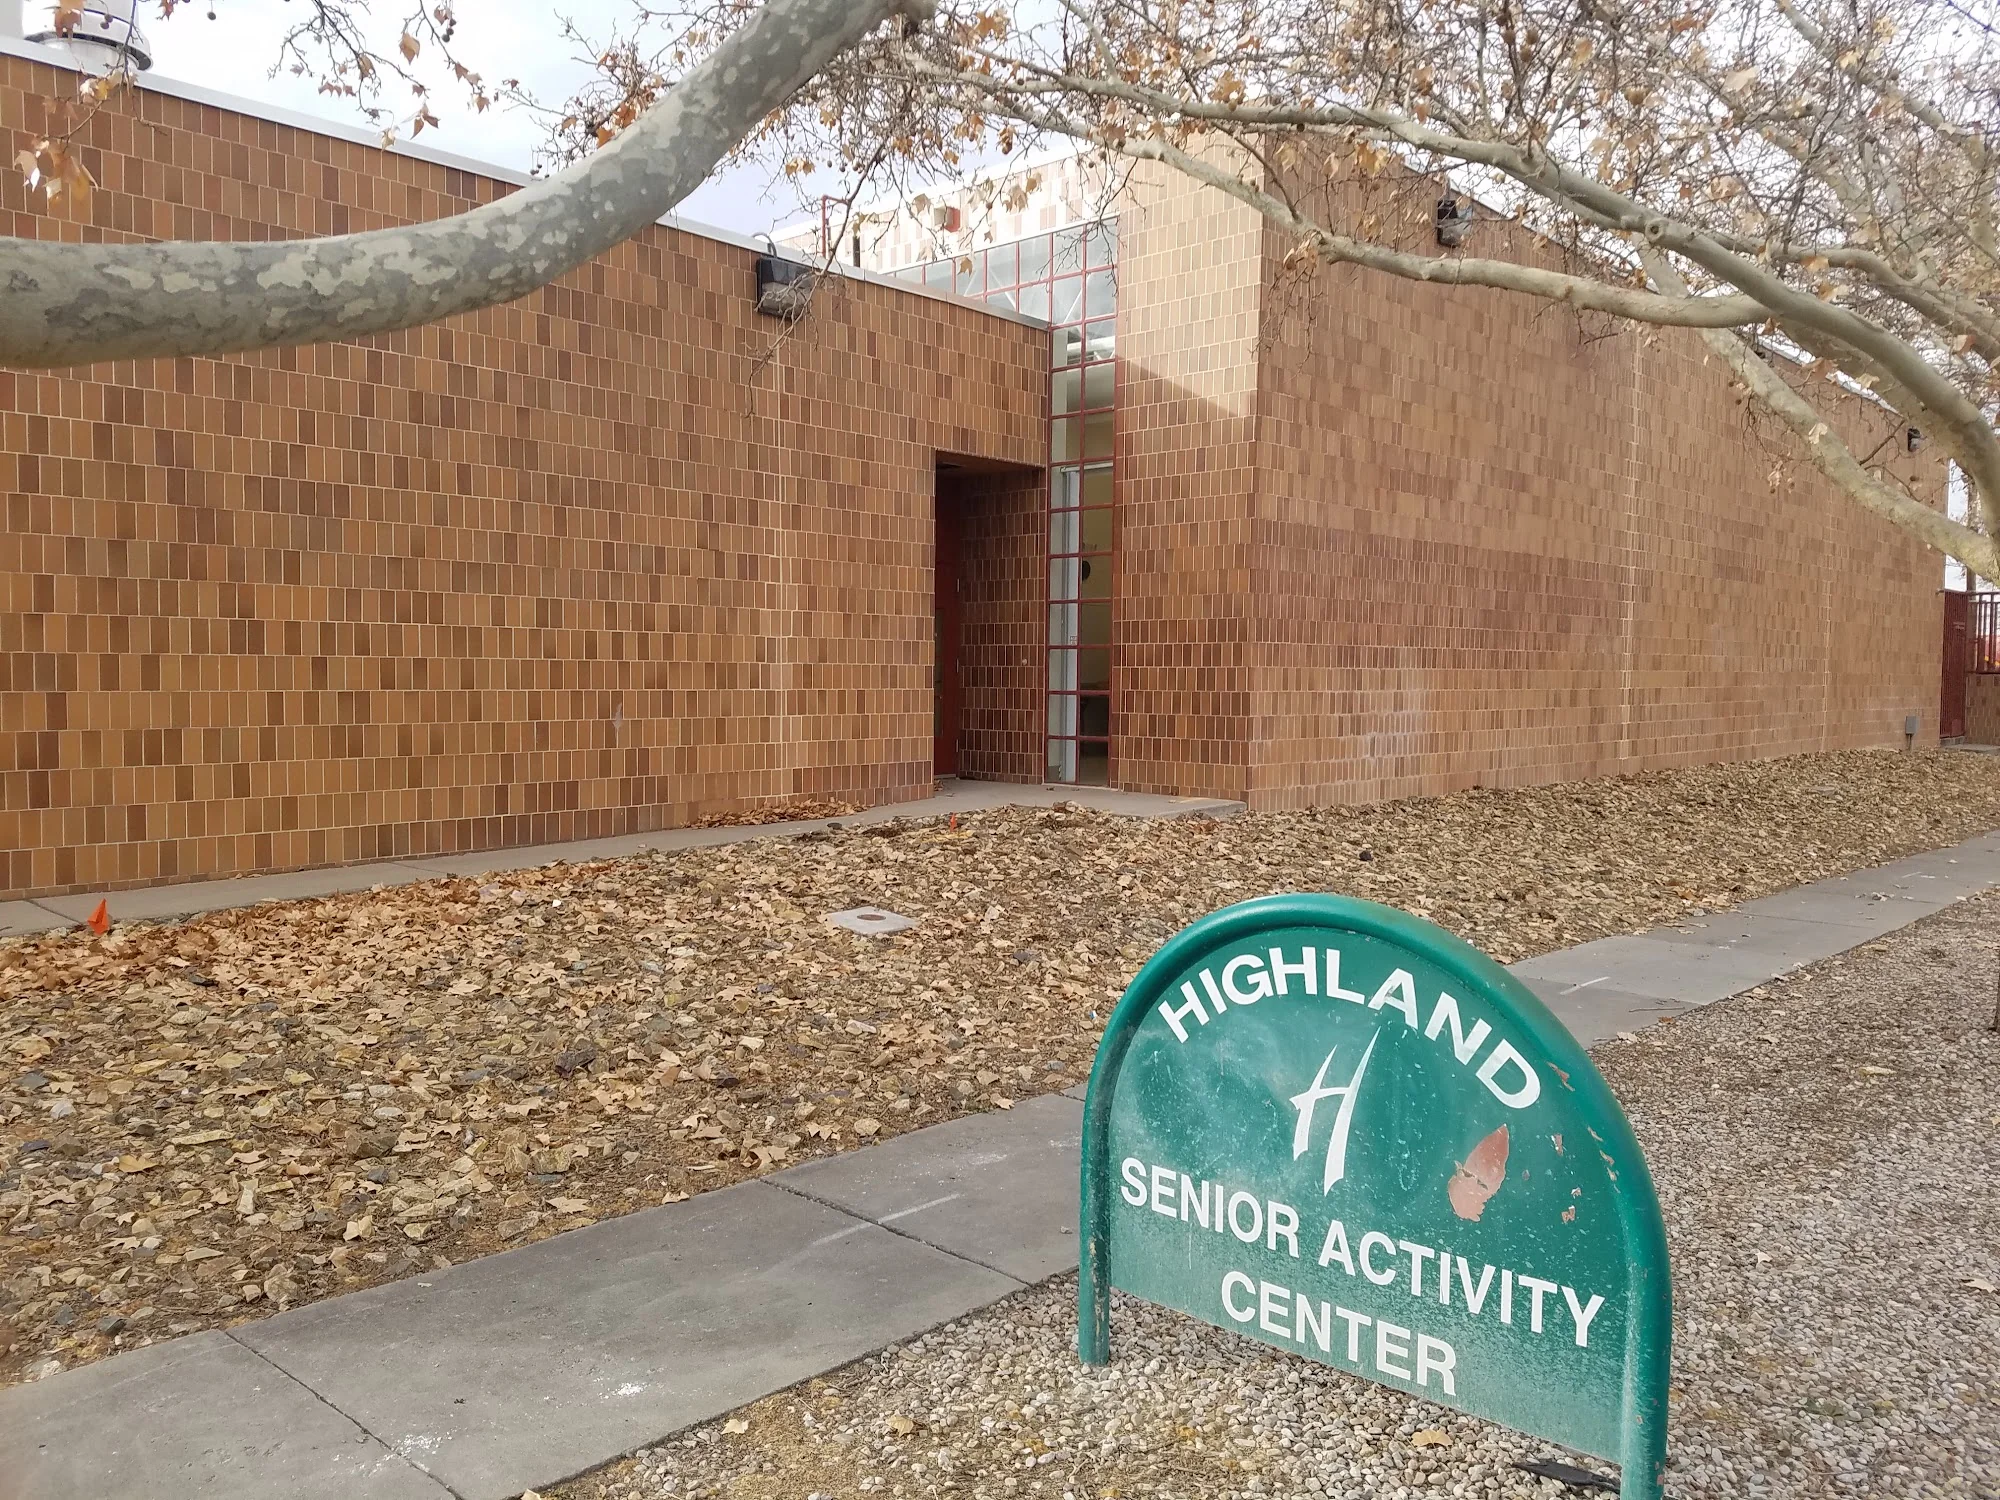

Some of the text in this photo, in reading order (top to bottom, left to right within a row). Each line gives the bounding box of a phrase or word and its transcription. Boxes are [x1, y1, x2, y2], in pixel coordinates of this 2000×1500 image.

[1157, 946, 1541, 1109] HIGHLAND
[1120, 1157, 1605, 1348] SENIOR ACTIVITY
[1221, 1271, 1457, 1396] CENTER
